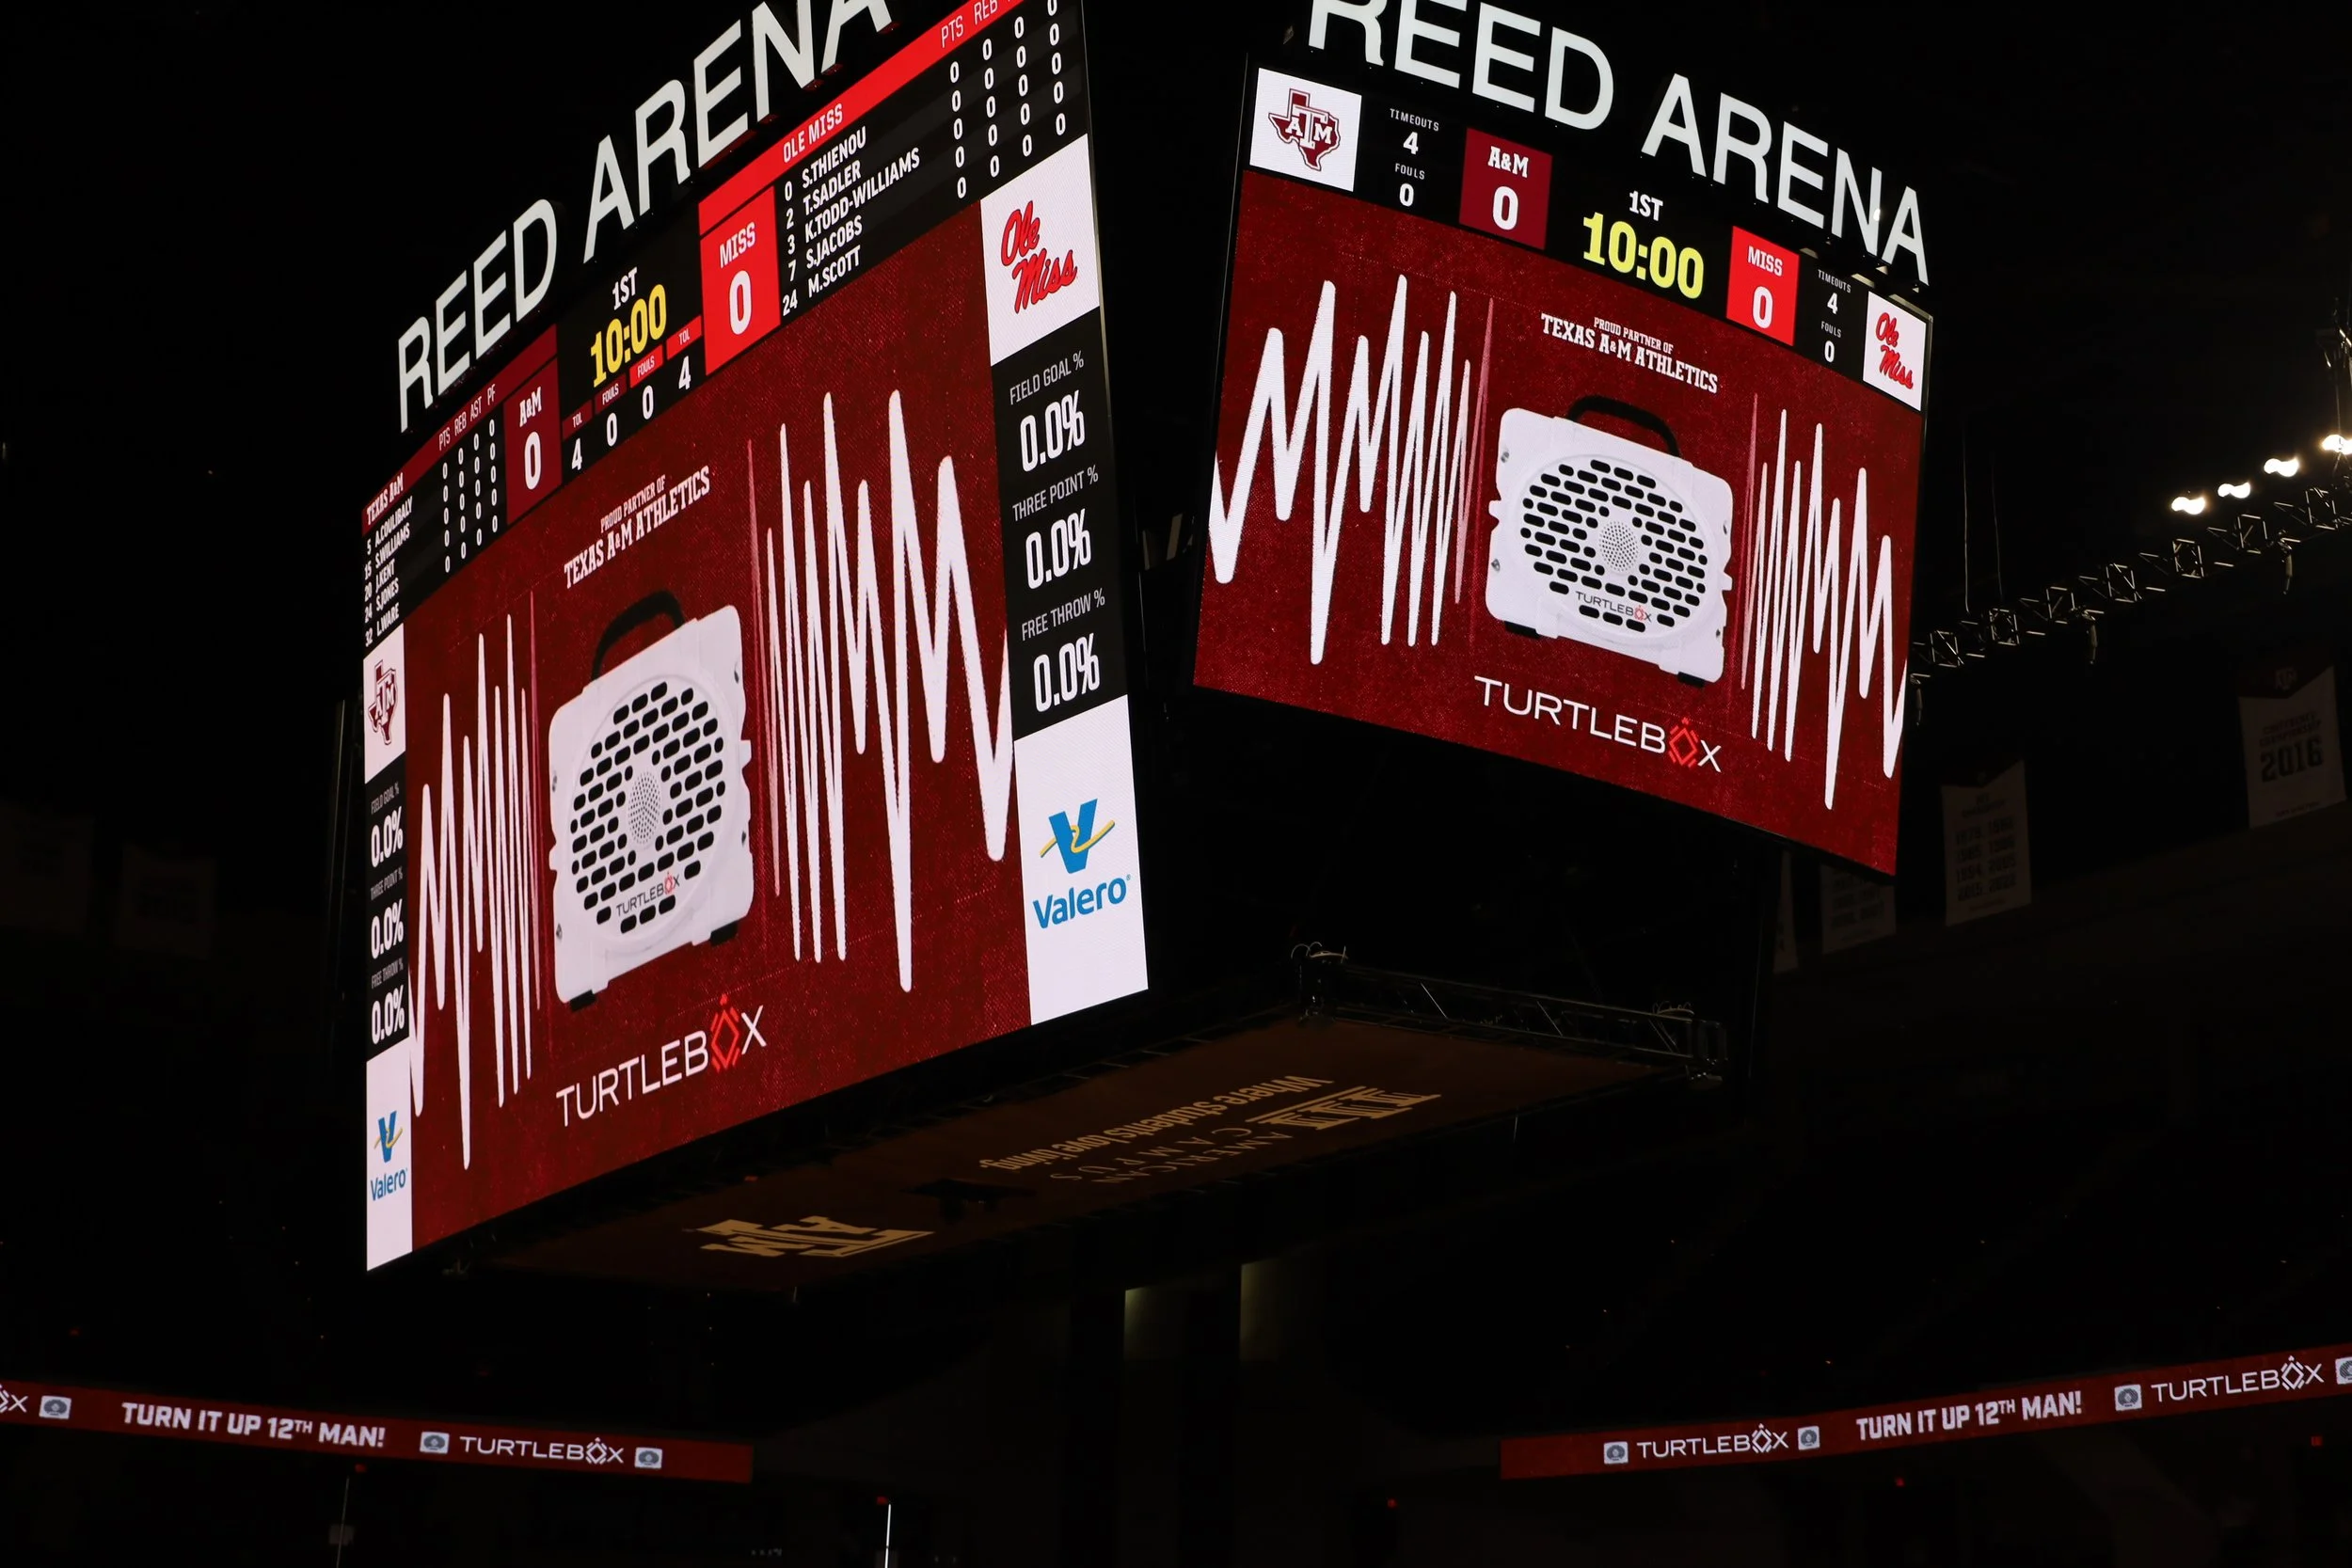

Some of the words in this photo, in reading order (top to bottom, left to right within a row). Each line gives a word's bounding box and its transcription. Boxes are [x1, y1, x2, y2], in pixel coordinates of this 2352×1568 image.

[783, 130, 805, 164] OLE
[808, 103, 843, 145] MISS
[941, 15, 964, 48] PTS
[785, 181, 792, 201] 0
[802, 126, 866, 189] S.THIENOU
[950, 61, 960, 83] 0
[982, 39, 993, 60] 0
[1014, 16, 1025, 39] 0
[786, 207, 794, 230] 2
[803, 160, 862, 216] T.SADLER
[951, 90, 961, 112] 0
[984, 68, 994, 89] 0
[1016, 46, 1026, 68] 0
[1049, 24, 1059, 46] 0
[1390, 108, 1439, 132] TIMEOUTS
[1403, 132, 1419, 155] 4
[787, 234, 796, 255] 3
[804, 147, 920, 244] K.TODD-WILLIAMS
[953, 119, 962, 140] 0
[986, 96, 996, 118] 0
[1018, 74, 1028, 97] 0
[1051, 52, 1061, 75] 0
[1394, 163, 1425, 181] FOULS
[1487, 146, 1529, 179] A&M
[1641, 72, 1930, 287] ARENA
[787, 260, 797, 282] 7
[805, 214, 863, 269] S.JACOBS
[955, 146, 964, 167] 0
[988, 124, 997, 147] 0
[1020, 103, 1030, 125] 0
[1054, 81, 1064, 103] 0
[1399, 182, 1414, 207] 0
[1629, 190, 1663, 221] 1ST
[783, 289, 798, 317] 24
[808, 245, 861, 298] M.SCOTT
[957, 177, 966, 198] 0
[990, 155, 1000, 178] 0
[1022, 135, 1032, 157] 0
[1056, 113, 1066, 135] 0
[1001, 200, 1041, 266] Ole
[1492, 186, 1519, 230] 0
[719, 221, 756, 269] MISS
[1583, 212, 1704, 299] 10:00
[1747, 245, 1783, 277] MISS
[612, 266, 638, 310] 1ST
[728, 270, 752, 335] 0
[1011, 247, 1077, 313] Miss
[1818, 269, 1851, 293] TIMEOUTS
[1827, 293, 1838, 315] 4
[398, 198, 557, 433] REED
[1752, 285, 1773, 329] 0
[1820, 321, 1842, 338] FOULS
[1876, 312, 1899, 347] Ole
[590, 284, 667, 388] 10:00
[1541, 313, 1596, 349] TEXAS
[1599, 333, 1631, 362] A&M
[1634, 346, 1718, 394] ATHLETICS
[1593, 317, 1621, 336] PROUD
[1623, 327, 1661, 349] PARTNER
[1662, 341, 1674, 355] OF
[1824, 341, 1836, 363] 0
[601, 383, 619, 405] FOULS
[637, 355, 656, 379] FOULS
[678, 328, 691, 346] TOL
[1009, 373, 1041, 405] FIELD
[1042, 357, 1072, 386] GOAL
[1073, 350, 1084, 370] %
[1879, 344, 1914, 389] Miss
[519, 386, 542, 428] A&M
[571, 437, 582, 470] 4
[607, 412, 618, 447] 0
[642, 385, 654, 420] 0
[678, 356, 691, 390] 4
[1019, 389, 1086, 472] 0.0%
[367, 488, 389, 525] TEXAS
[438, 427, 451, 451] PTS
[454, 411, 467, 436] REB
[470, 396, 483, 422] AST
[487, 384, 496, 405] PF
[524, 432, 542, 489] 0
[600, 506, 623, 533] PROUD
[623, 482, 656, 518] PARTNER
[657, 474, 666, 493] OF
[1012, 490, 1047, 522] THREE
[1049, 470, 1085, 505] POINT
[1087, 464, 1099, 483] %
[564, 538, 604, 589] TEXAS
[607, 518, 633, 561] A&M
[636, 465, 710, 541] ATHLETICS
[1025, 508, 1091, 590] 0.0%
[1021, 610, 1049, 641] FREE
[1051, 593, 1091, 626] THROW
[1093, 587, 1105, 608] %
[1576, 591, 1652, 623] TURTLEBOX
[1033, 632, 1101, 712] 0.0%
[1474, 674, 1722, 773] TURTLEBOX
[2260, 735, 2324, 783] 2016
[371, 806, 404, 867] 0.0%
[616, 871, 680, 917] TURTLEBOX
[1033, 877, 1127, 929] Valero
[371, 898, 405, 959] 0.0%
[371, 984, 405, 1044] 0.0%
[555, 993, 767, 1127] TURTLEBOX
[1213, 1075, 1334, 1105] Where
[1051, 1134, 1131, 1153] love
[1103, 1101, 1228, 1138] students
[1050, 1128, 1251, 1180] CAMPUS
[1091, 1132, 1293, 1183] AMERICAN
[371, 1168, 406, 1201] Valero
[2151, 1355, 2325, 1402] TURTLEBOX
[121, 1402, 190, 1430] TURN
[198, 1410, 222, 1433] IT
[227, 1414, 262, 1436] UP
[318, 1422, 386, 1448] MAN!
[1636, 1422, 1789, 1459] TURTLEBOX
[1856, 1412, 1913, 1441] TURN
[1917, 1409, 1937, 1433] IT
[1942, 1404, 1970, 1431] UP
[2022, 1390, 2082, 1421] MAN!
[459, 1435, 625, 1465] TURTLEBOX
